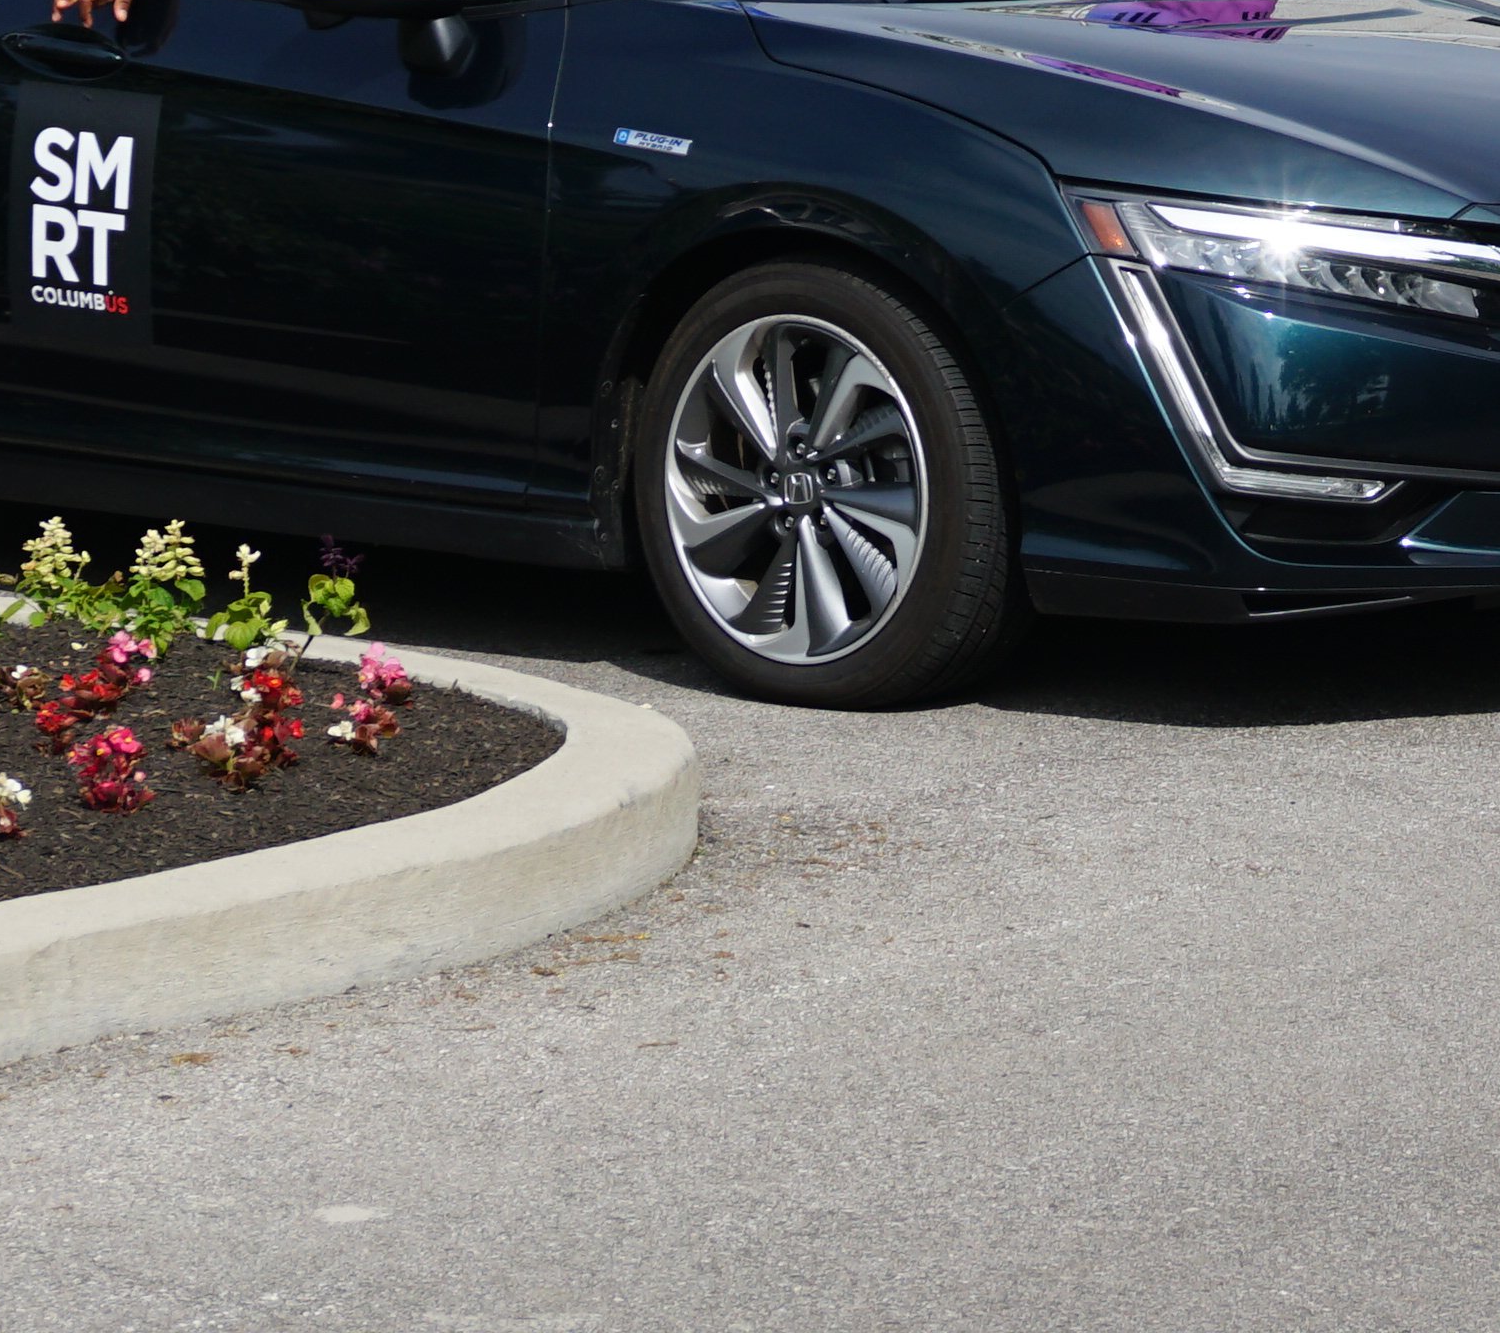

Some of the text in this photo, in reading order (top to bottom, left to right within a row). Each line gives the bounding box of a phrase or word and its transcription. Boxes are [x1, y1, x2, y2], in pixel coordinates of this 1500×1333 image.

[634, 132, 683, 147] PLUG-IN
[639, 141, 673, 151] HYBRID
[30, 126, 134, 210] SM
[32, 203, 126, 286] RT
[31, 285, 130, 315] COLUMBUS
